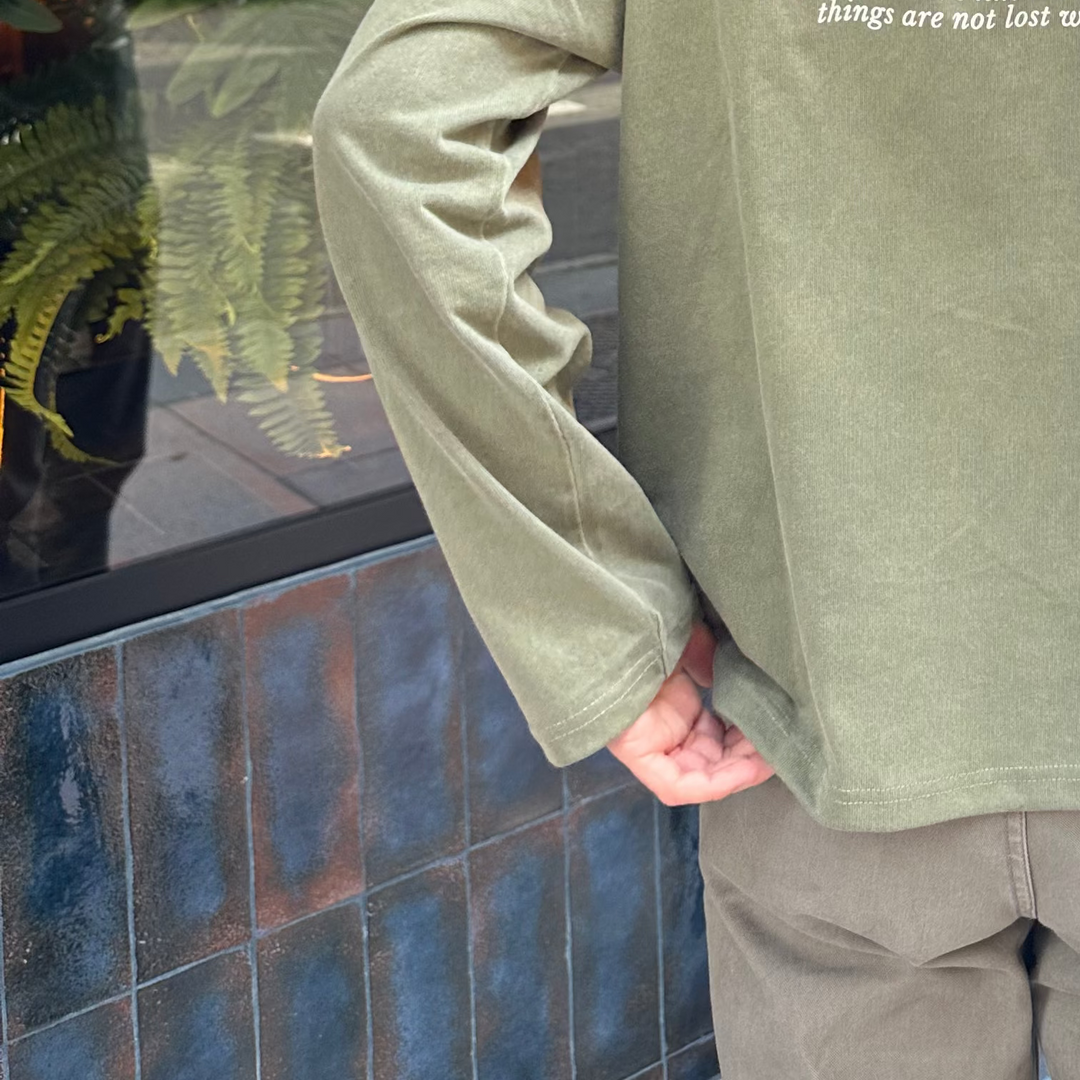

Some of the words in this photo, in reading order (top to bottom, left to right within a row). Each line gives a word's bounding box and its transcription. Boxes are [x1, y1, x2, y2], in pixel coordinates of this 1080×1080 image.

[901, 9, 945, 29] are
[951, 8, 997, 30] not
[1004, 3, 1051, 29] lost
